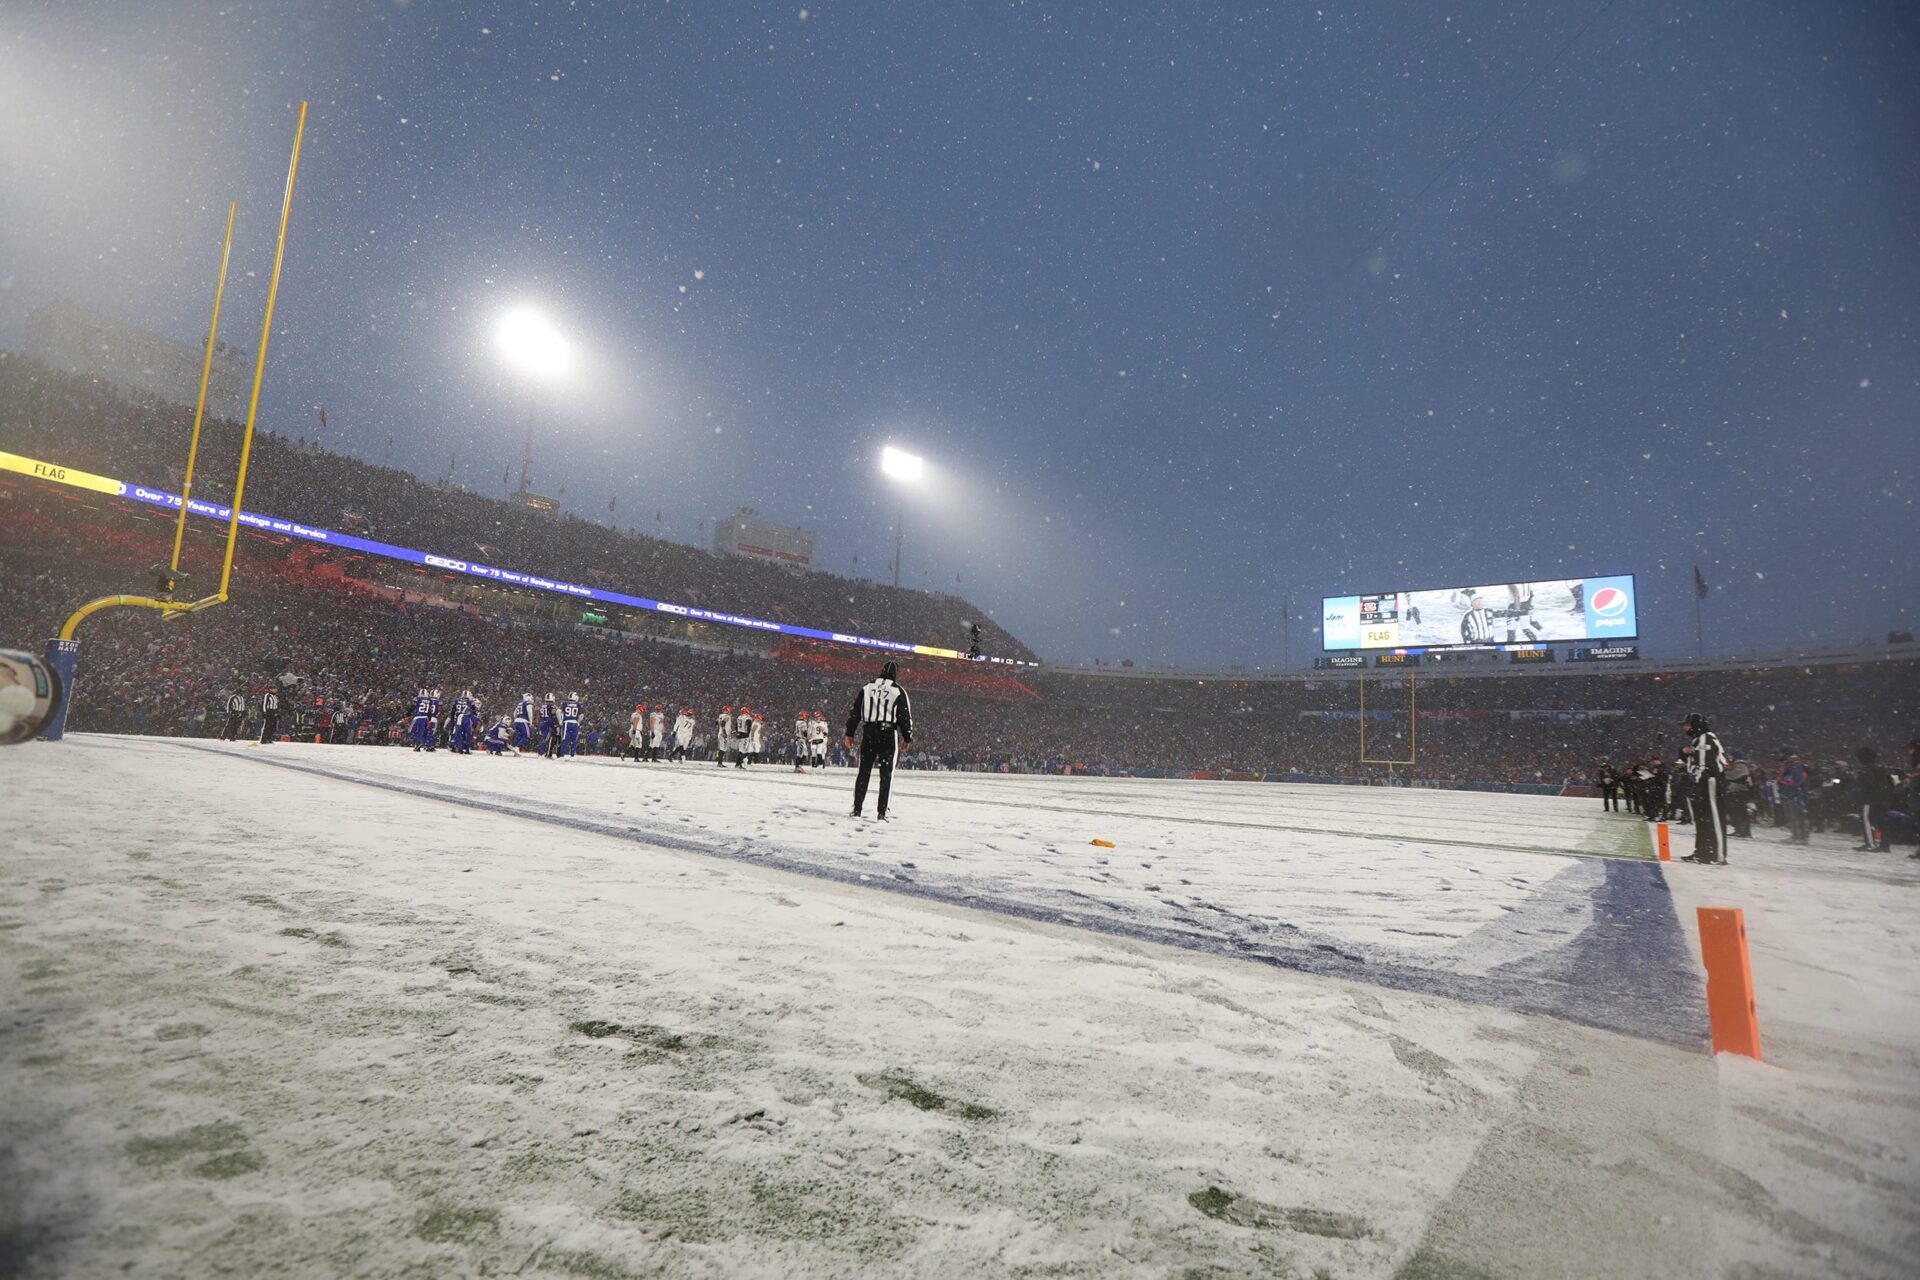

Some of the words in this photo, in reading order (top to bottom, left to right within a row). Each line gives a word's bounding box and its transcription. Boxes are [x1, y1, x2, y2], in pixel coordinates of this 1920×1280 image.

[34, 464, 65, 480] FLAG
[135, 488, 163, 501] Over
[167, 495, 183, 506] 75
[186, 500, 216, 514] Years
[218, 509, 230, 517] of
[238, 513, 271, 527] avings
[273, 520, 291, 531] and
[293, 525, 327, 539] Service
[425, 555, 467, 571] GEICO
[471, 565, 489, 574] Over
[490, 569, 500, 577] 75
[502, 571, 521, 580] Years
[530, 578, 555, 589] Savings
[569, 585, 591, 595] Service
[657, 603, 687, 615] GEICO
[1368, 631, 1390, 641] FLAG
[1517, 650, 1545, 659] HUNT
[1591, 647, 1633, 655] IMAGINE
[872, 689, 889, 699] 117
[419, 702, 430, 713] 21
[456, 704, 468, 713] 97
[565, 707, 579, 717] 90
